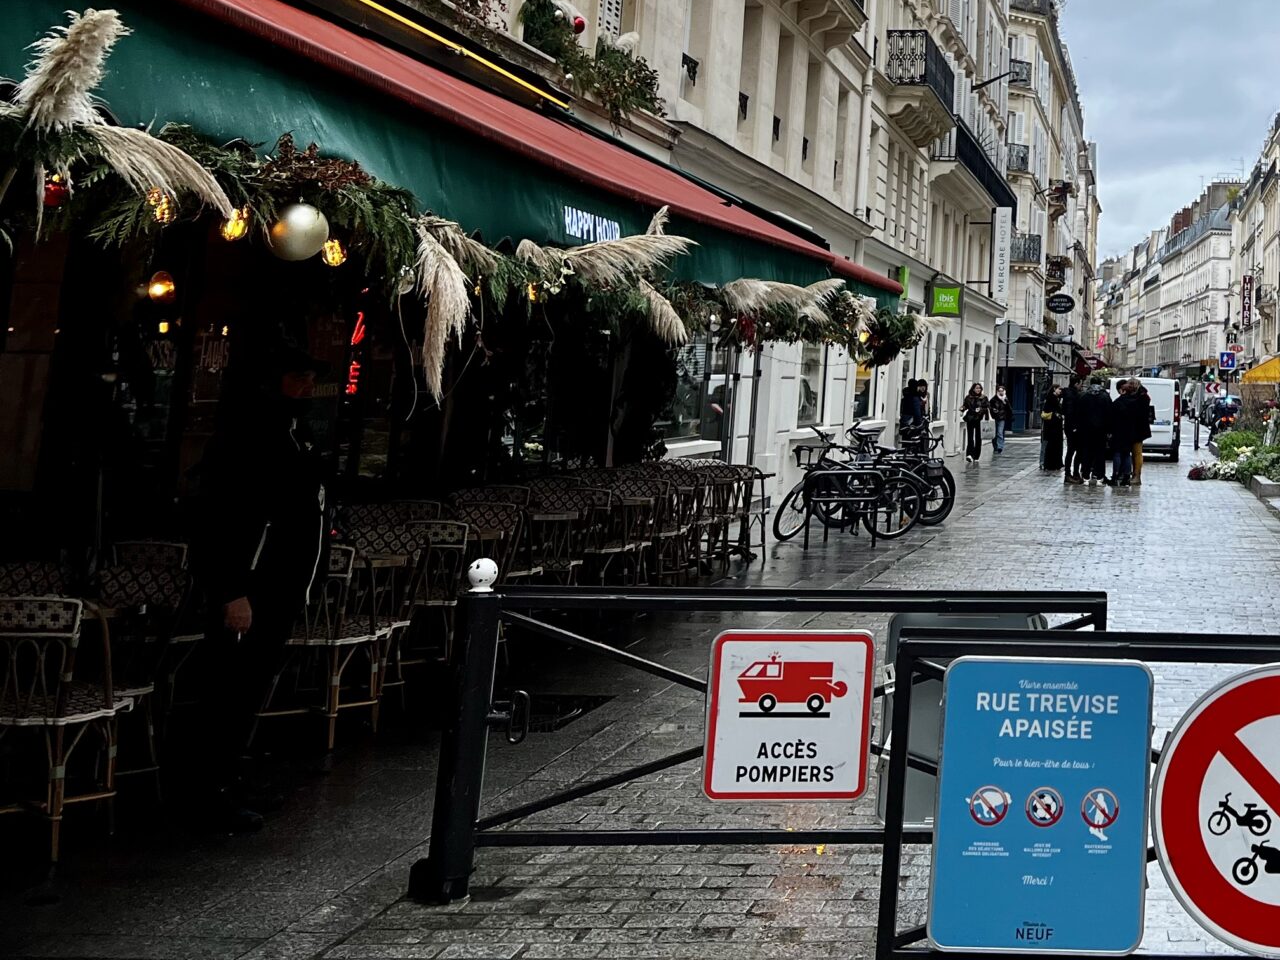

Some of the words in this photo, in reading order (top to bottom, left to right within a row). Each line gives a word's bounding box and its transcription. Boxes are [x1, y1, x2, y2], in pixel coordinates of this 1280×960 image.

[564, 205, 594, 242] HAPPY
[595, 215, 620, 243] HOUR
[998, 246, 1006, 293] MERCURE
[939, 293, 954, 303] ibis
[1018, 679, 1041, 689] Vivre
[1042, 680, 1079, 690] ensemble
[976, 692, 1021, 712] RUE
[1026, 693, 1119, 714] TREVISE
[998, 715, 1093, 740] APAISÉE
[756, 738, 818, 759] ACCÈS
[993, 756, 1014, 768] Pour
[1014, 757, 1023, 768] le
[1023, 758, 1060, 769] bien-être
[1061, 759, 1071, 769] de
[1072, 760, 1090, 769] tous
[735, 765, 834, 783] POMPIERS
[1022, 874, 1047, 886] Merci
[1015, 927, 1054, 940] NEUF
